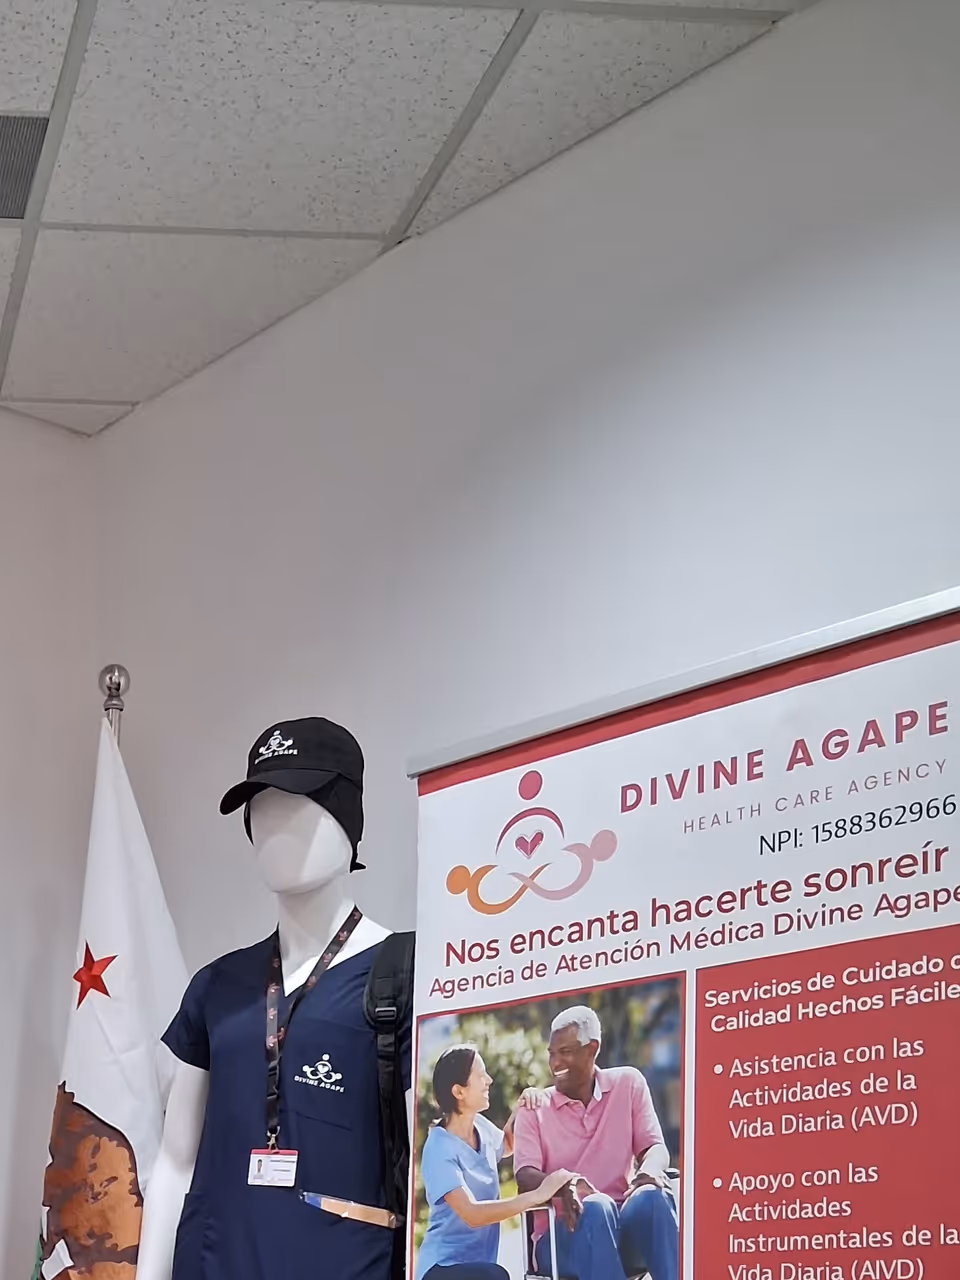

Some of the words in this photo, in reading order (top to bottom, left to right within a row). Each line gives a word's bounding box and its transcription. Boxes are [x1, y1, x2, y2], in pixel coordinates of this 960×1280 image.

[621, 749, 763, 813] DIVINE
[786, 701, 948, 773] AGAPE
[684, 803, 763, 833] HEALTH
[776, 786, 832, 811] CARE
[848, 759, 945, 794] AGENCY
[760, 828, 802, 855] NPI:
[811, 792, 956, 848] 1588362966
[446, 939, 502, 969] Nos
[510, 910, 641, 954] encanta
[652, 880, 792, 927] hacerte
[804, 841, 948, 897] sonreír
[430, 966, 514, 998] Agencia
[521, 960, 547, 980] de
[555, 939, 660, 974] Atención
[671, 917, 763, 953] Médica
[775, 899, 863, 935] Divine
[705, 979, 801, 1007] Servicios
[808, 972, 834, 990] de
[843, 956, 943, 985] Cuidado
[711, 1004, 790, 1031] Calidad
[799, 995, 883, 1020] Hechos
[730, 1048, 837, 1077] Asistencia
[844, 1045, 883, 1063] con
[894, 1038, 923, 1058] las
[729, 1078, 851, 1108] Actividades
[861, 1073, 888, 1094] de
[898, 1070, 916, 1090] la
[729, 1117, 774, 1138] Vida
[782, 1111, 844, 1134] Diaria
[852, 1102, 917, 1131] (AVD)
[729, 1173, 794, 1195] Apoyo
[802, 1170, 839, 1186] con
[849, 1163, 877, 1182] las
[729, 1197, 851, 1222] Actividades
[730, 1227, 892, 1253] Instrumentales
[903, 1225, 931, 1246] de
[941, 1224, 959, 1244] la
